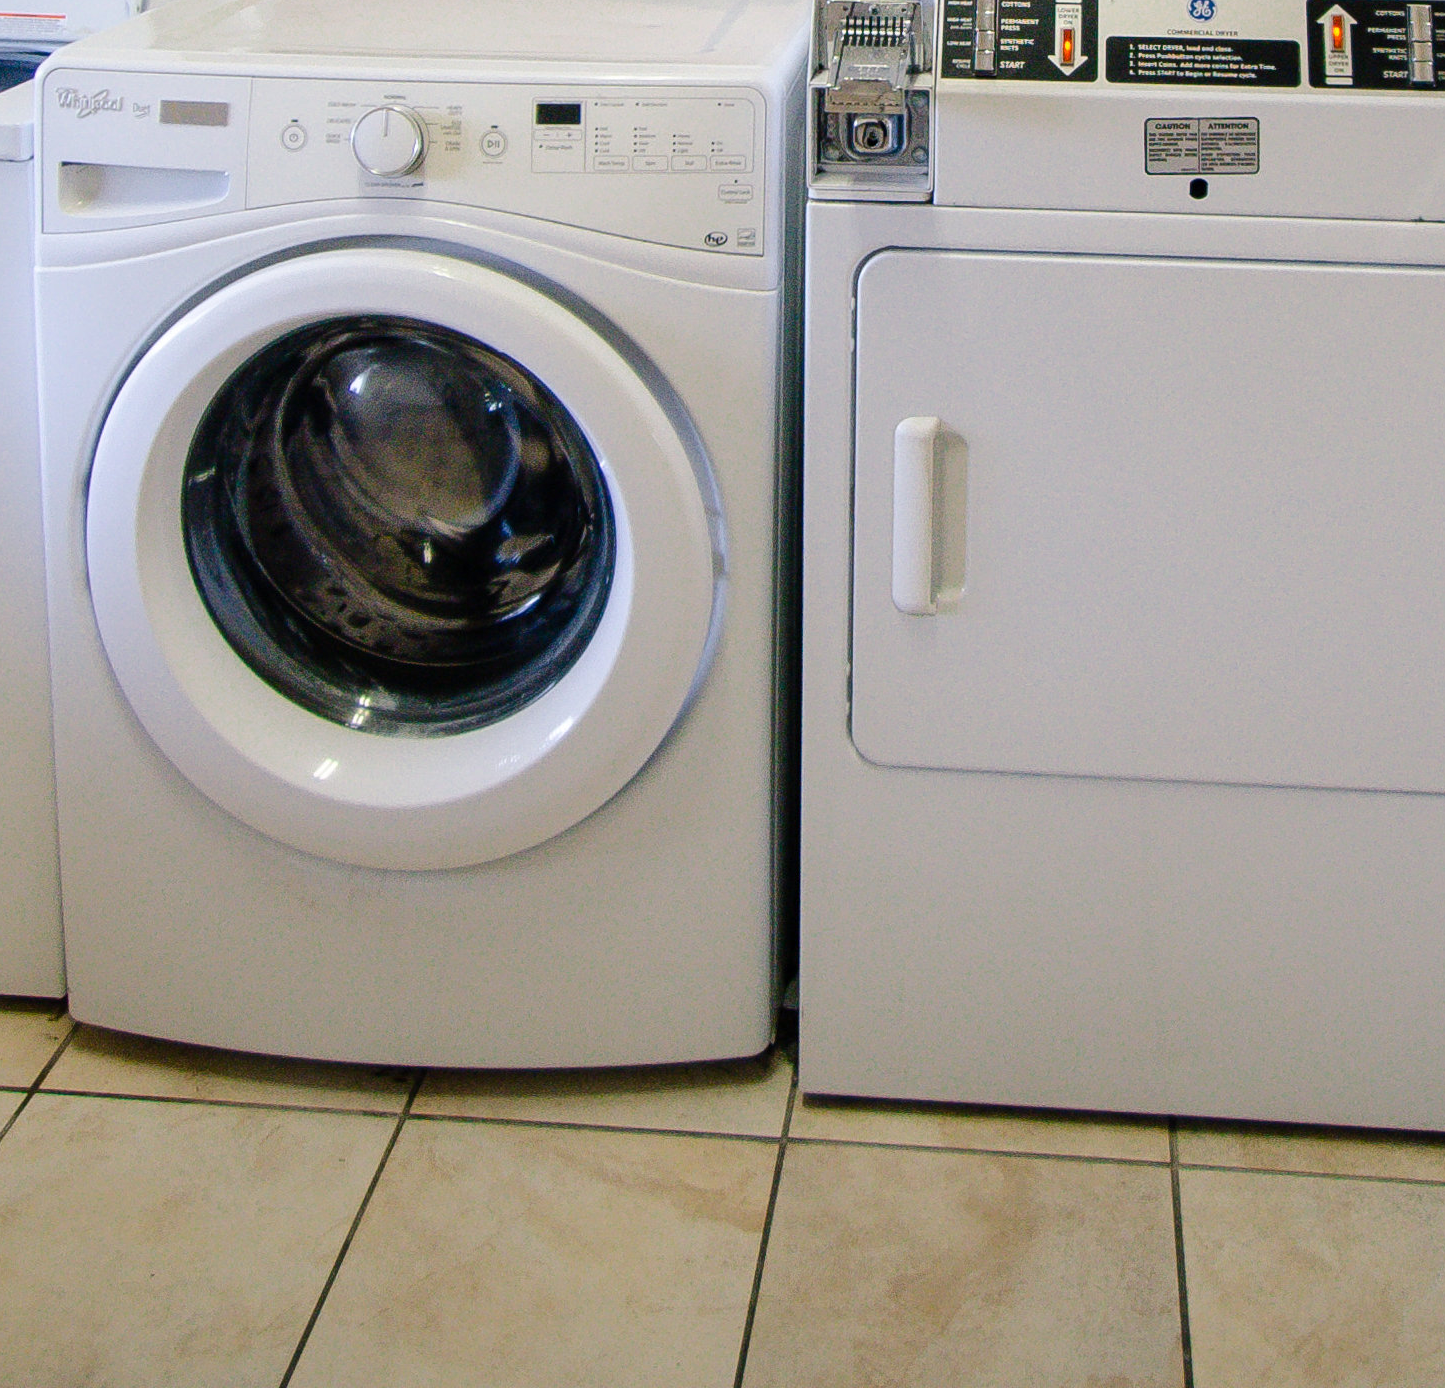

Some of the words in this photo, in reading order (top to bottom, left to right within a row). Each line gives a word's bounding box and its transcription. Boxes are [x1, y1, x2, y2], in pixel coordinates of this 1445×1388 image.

[1163, 44, 1185, 52] DRYER,
[1000, 61, 1026, 69] START
[1383, 71, 1408, 79] START
[56, 88, 123, 119] Whirlpool
